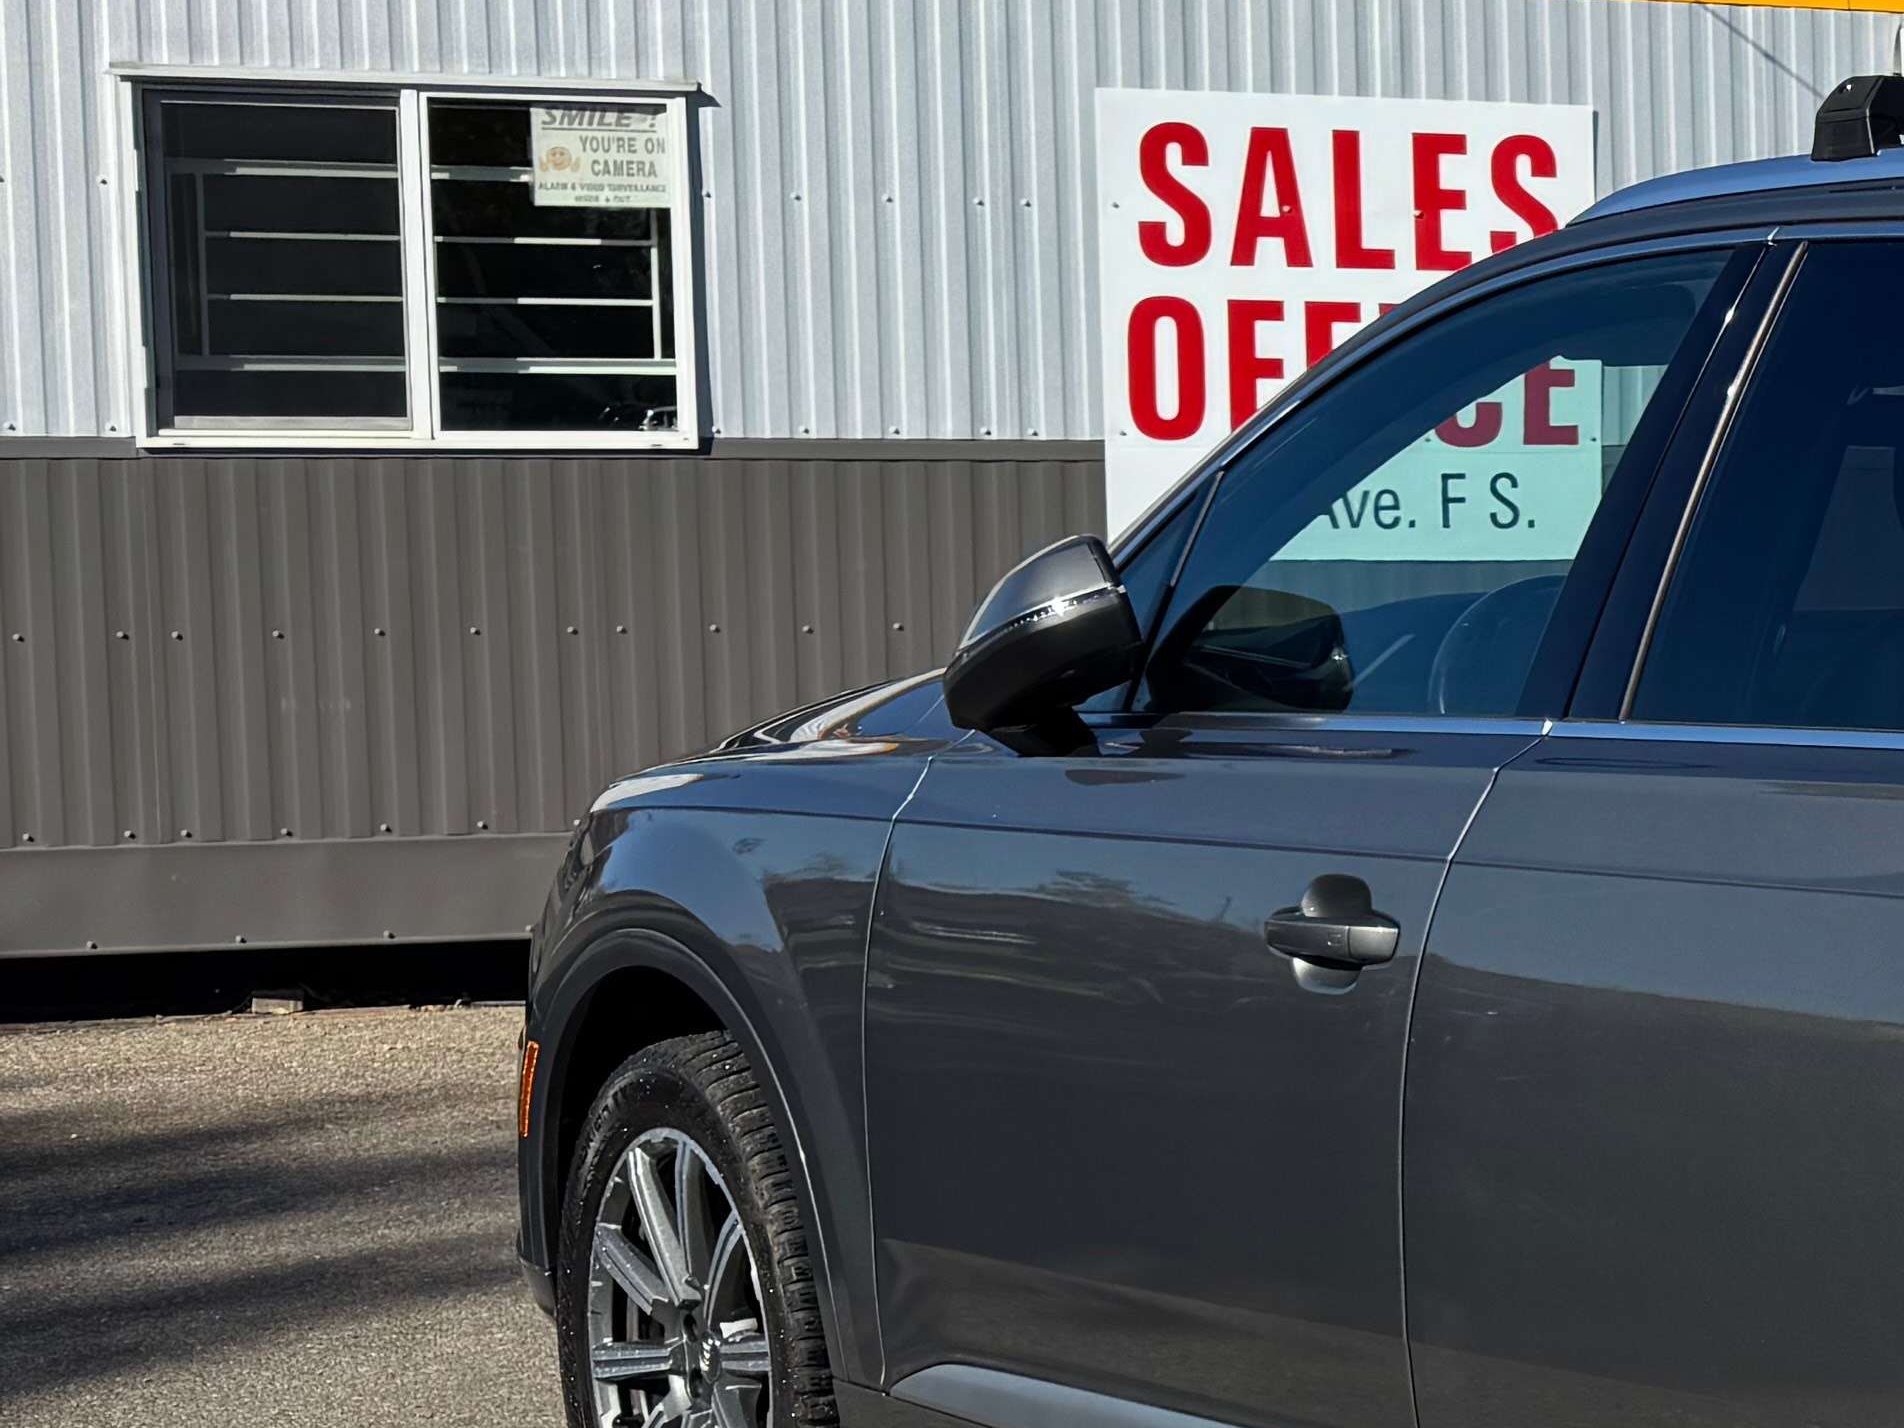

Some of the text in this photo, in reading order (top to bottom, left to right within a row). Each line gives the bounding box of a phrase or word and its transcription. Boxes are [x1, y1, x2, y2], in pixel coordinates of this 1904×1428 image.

[579, 135, 666, 155] YOU'RE ON
[590, 159, 658, 178] CAMERA
[1137, 121, 1560, 272] SALES
[1127, 295, 1580, 448] OFE
[1439, 473, 1467, 530] F
[1488, 472, 1536, 530] S.
